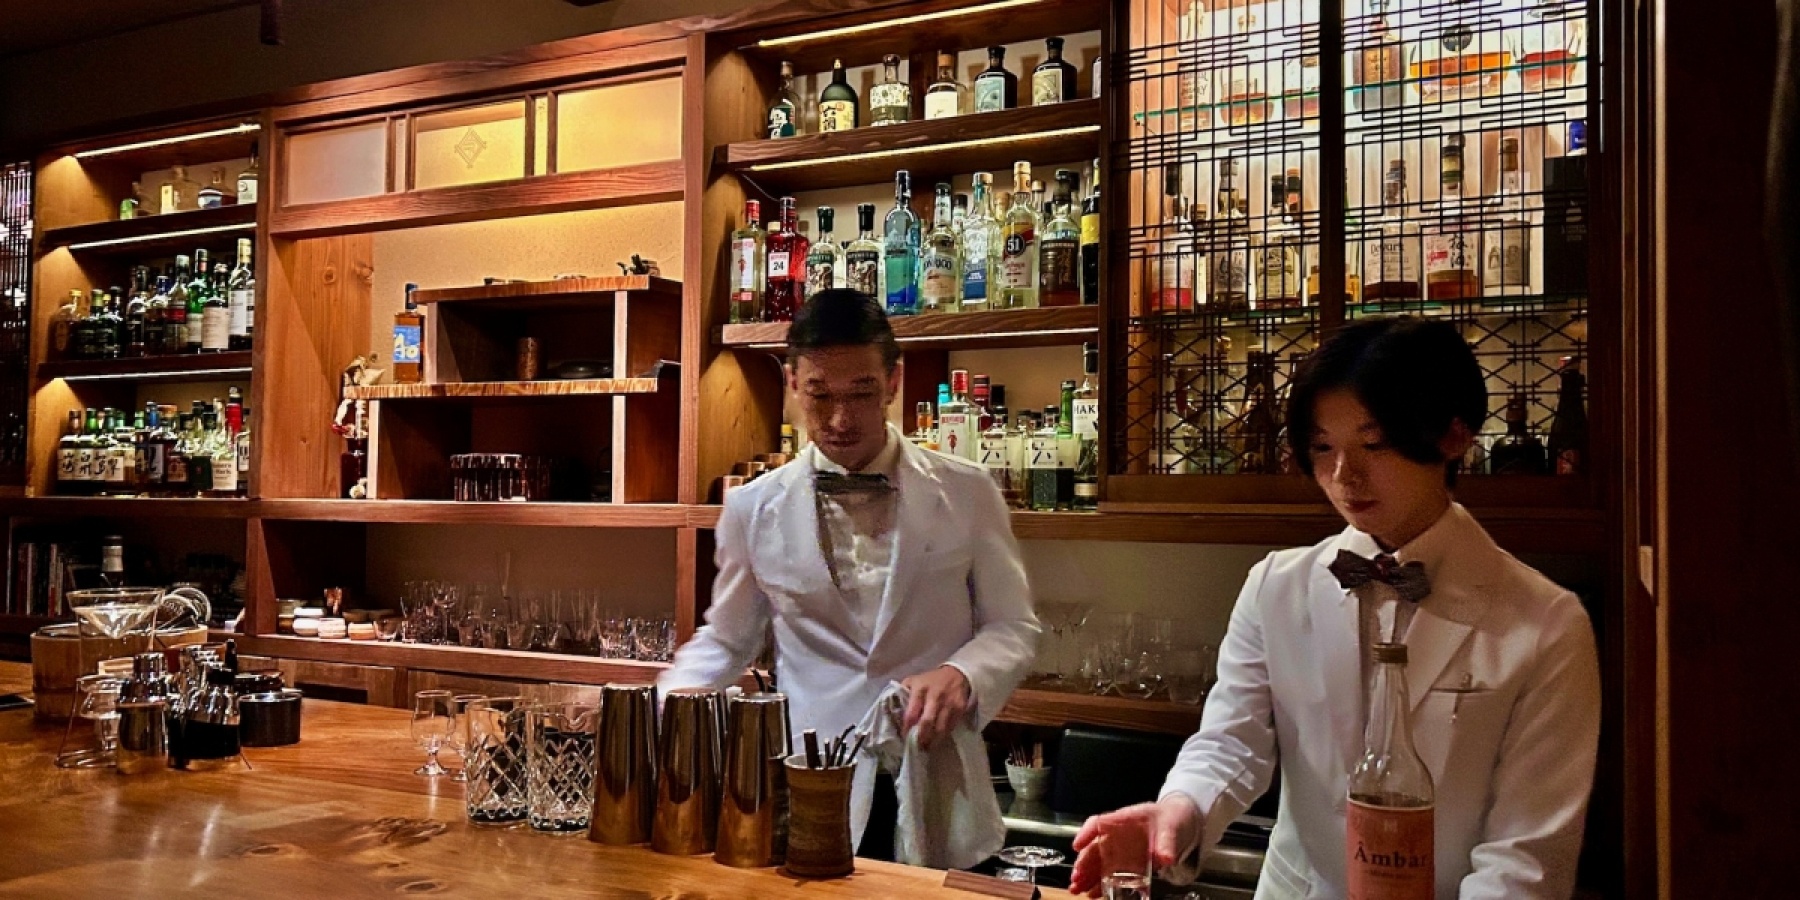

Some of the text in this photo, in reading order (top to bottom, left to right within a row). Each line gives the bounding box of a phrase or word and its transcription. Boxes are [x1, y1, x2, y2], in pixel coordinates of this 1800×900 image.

[1007, 238, 1020, 252] 51
[773, 261, 784, 271] 24
[1354, 841, 1428, 868] Âmbar
